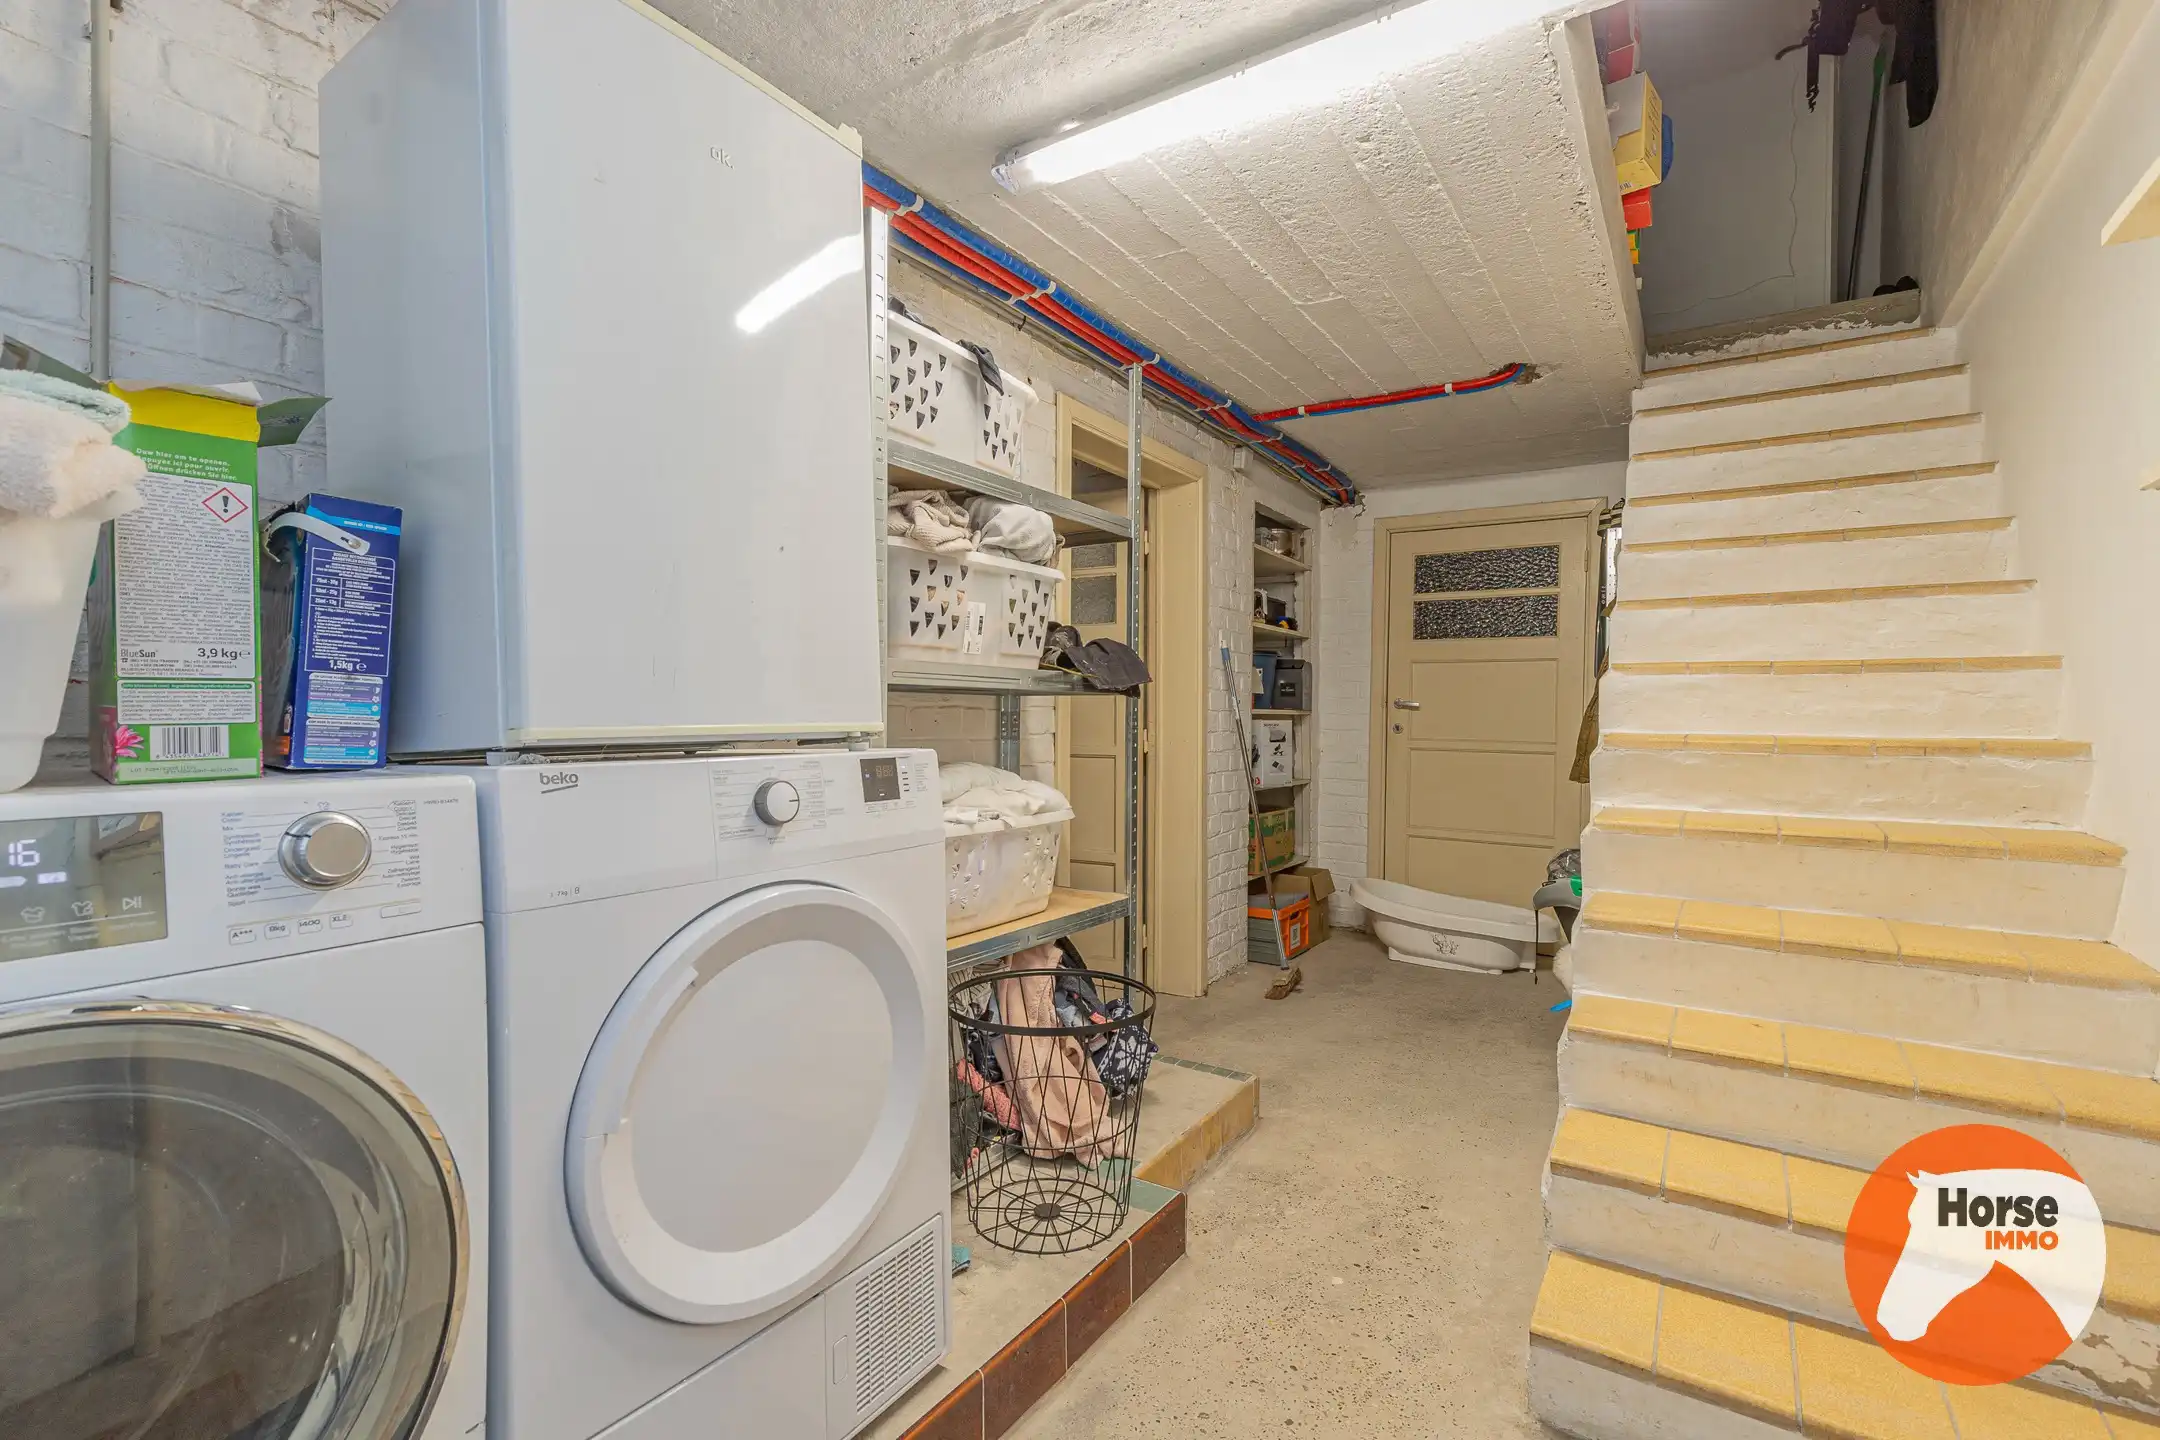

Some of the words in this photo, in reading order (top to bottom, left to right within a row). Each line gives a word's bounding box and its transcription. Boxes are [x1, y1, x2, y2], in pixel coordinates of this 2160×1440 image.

[136, 448, 154, 456] Duw
[156, 450, 172, 458] hier
[120, 648, 156, 658] BlueSun
[197, 647, 219, 659] 3,9
[221, 648, 238, 660] kg
[328, 660, 353, 671] 1,5kg
[539, 771, 579, 785] beko
